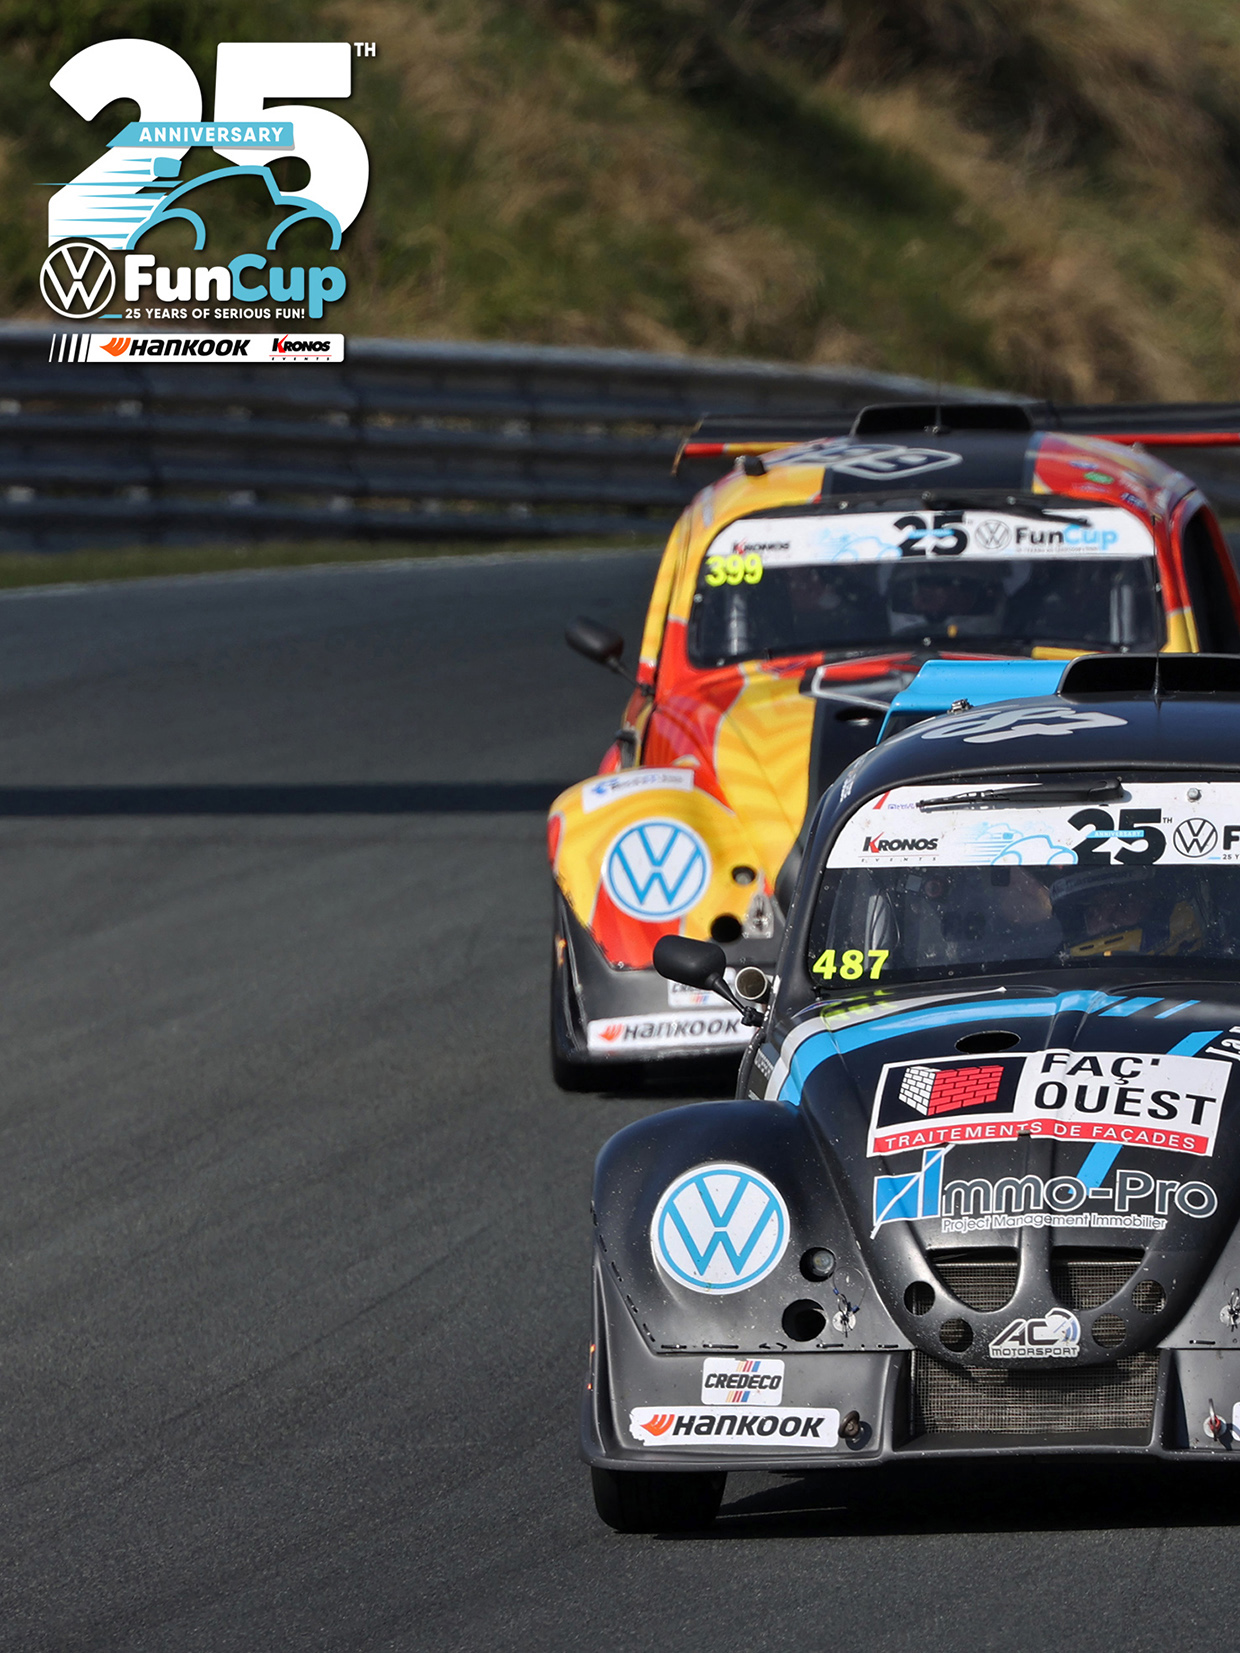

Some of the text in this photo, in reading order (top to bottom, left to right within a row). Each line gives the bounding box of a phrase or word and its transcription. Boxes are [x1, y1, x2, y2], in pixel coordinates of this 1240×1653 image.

[893, 511, 968, 556] 25
[1016, 524, 1118, 550] FunCup
[704, 553, 763, 587] 399
[862, 832, 939, 853] KRONOS
[1067, 808, 1167, 865] 25
[812, 949, 889, 980] 487
[1034, 1080, 1217, 1126] OUEST
[885, 1121, 1196, 1150] TRAITEMENTS DE FAÇADES
[942, 1213, 1168, 1233] Project Management Immobilier
[991, 1347, 1078, 1357] MOTORSPORT
[704, 1373, 782, 1390] CREDECO
